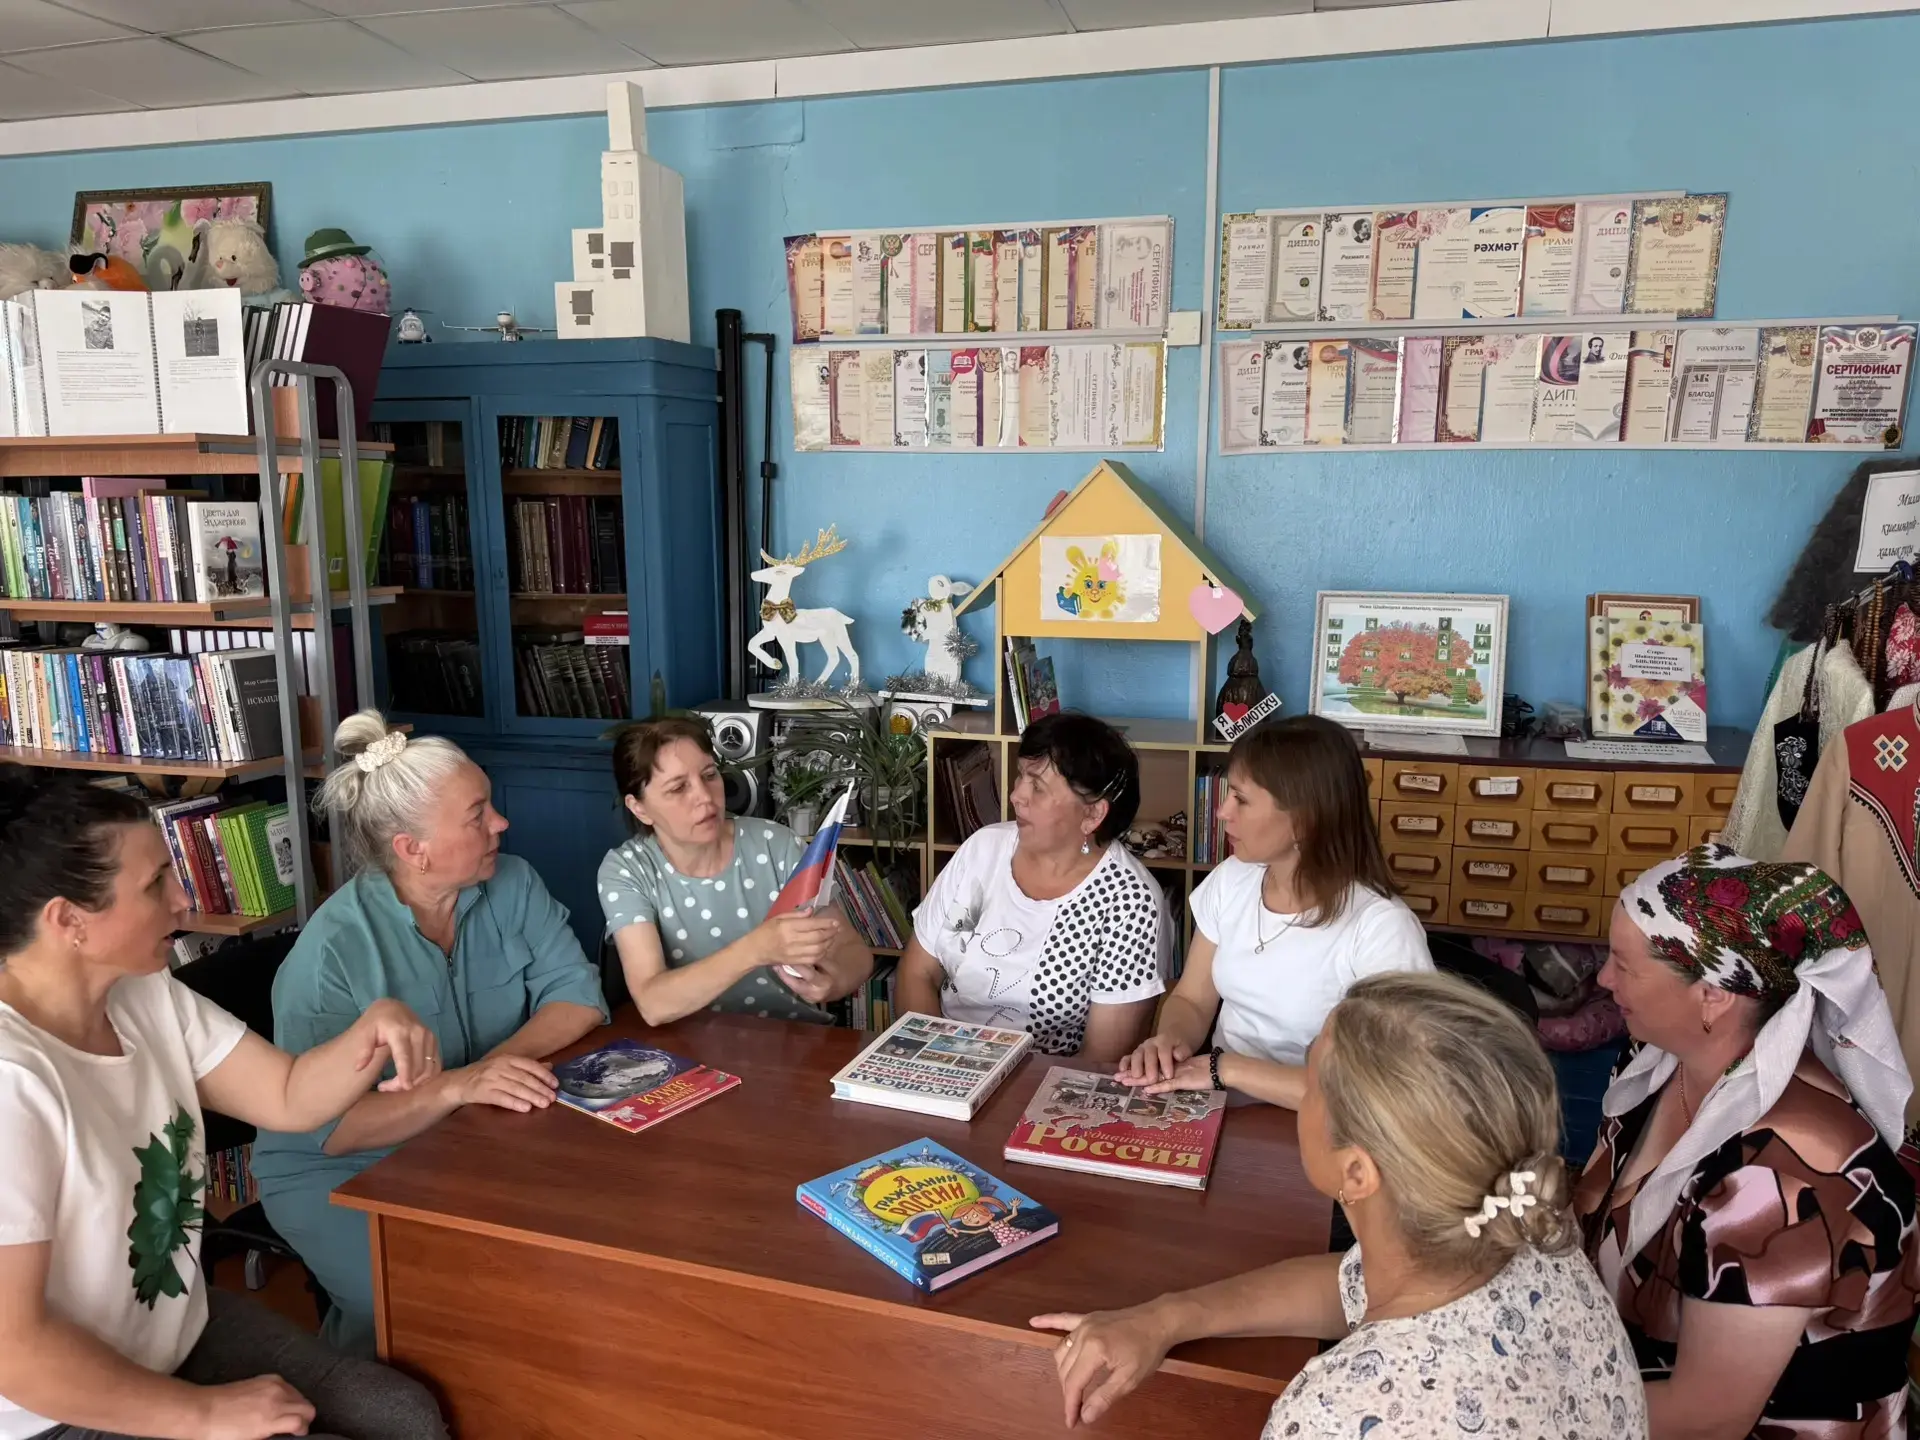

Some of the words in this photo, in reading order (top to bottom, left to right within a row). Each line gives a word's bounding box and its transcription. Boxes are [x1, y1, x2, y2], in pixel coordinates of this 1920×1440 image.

[1474, 242, 1519, 252] РӘХМӘТ
[1150, 243, 1161, 312] СЕРТИФИКАТ
[1826, 364, 1902, 375] СЕРТИФИКАТ
[34, 545, 45, 569] Вера
[248, 694, 279, 706] ИСКАНД
[234, 704, 246, 744] ИСКАНДЕР
[1217, 716, 1228, 728] Я
[1225, 695, 1279, 740] БИБЛИОТЕКУ
[858, 1063, 913, 1077] ДЕТСКАЯ
[915, 1074, 977, 1088] БОЛЬШАЯ
[638, 1079, 694, 1105] ЗЕМЛЯ
[847, 1071, 969, 1098] РОССИЙСКАЯ
[873, 1174, 958, 1211] ГРАЖДАНИН
[893, 1175, 911, 1188] Я
[888, 1182, 966, 1217] РОССИИ
